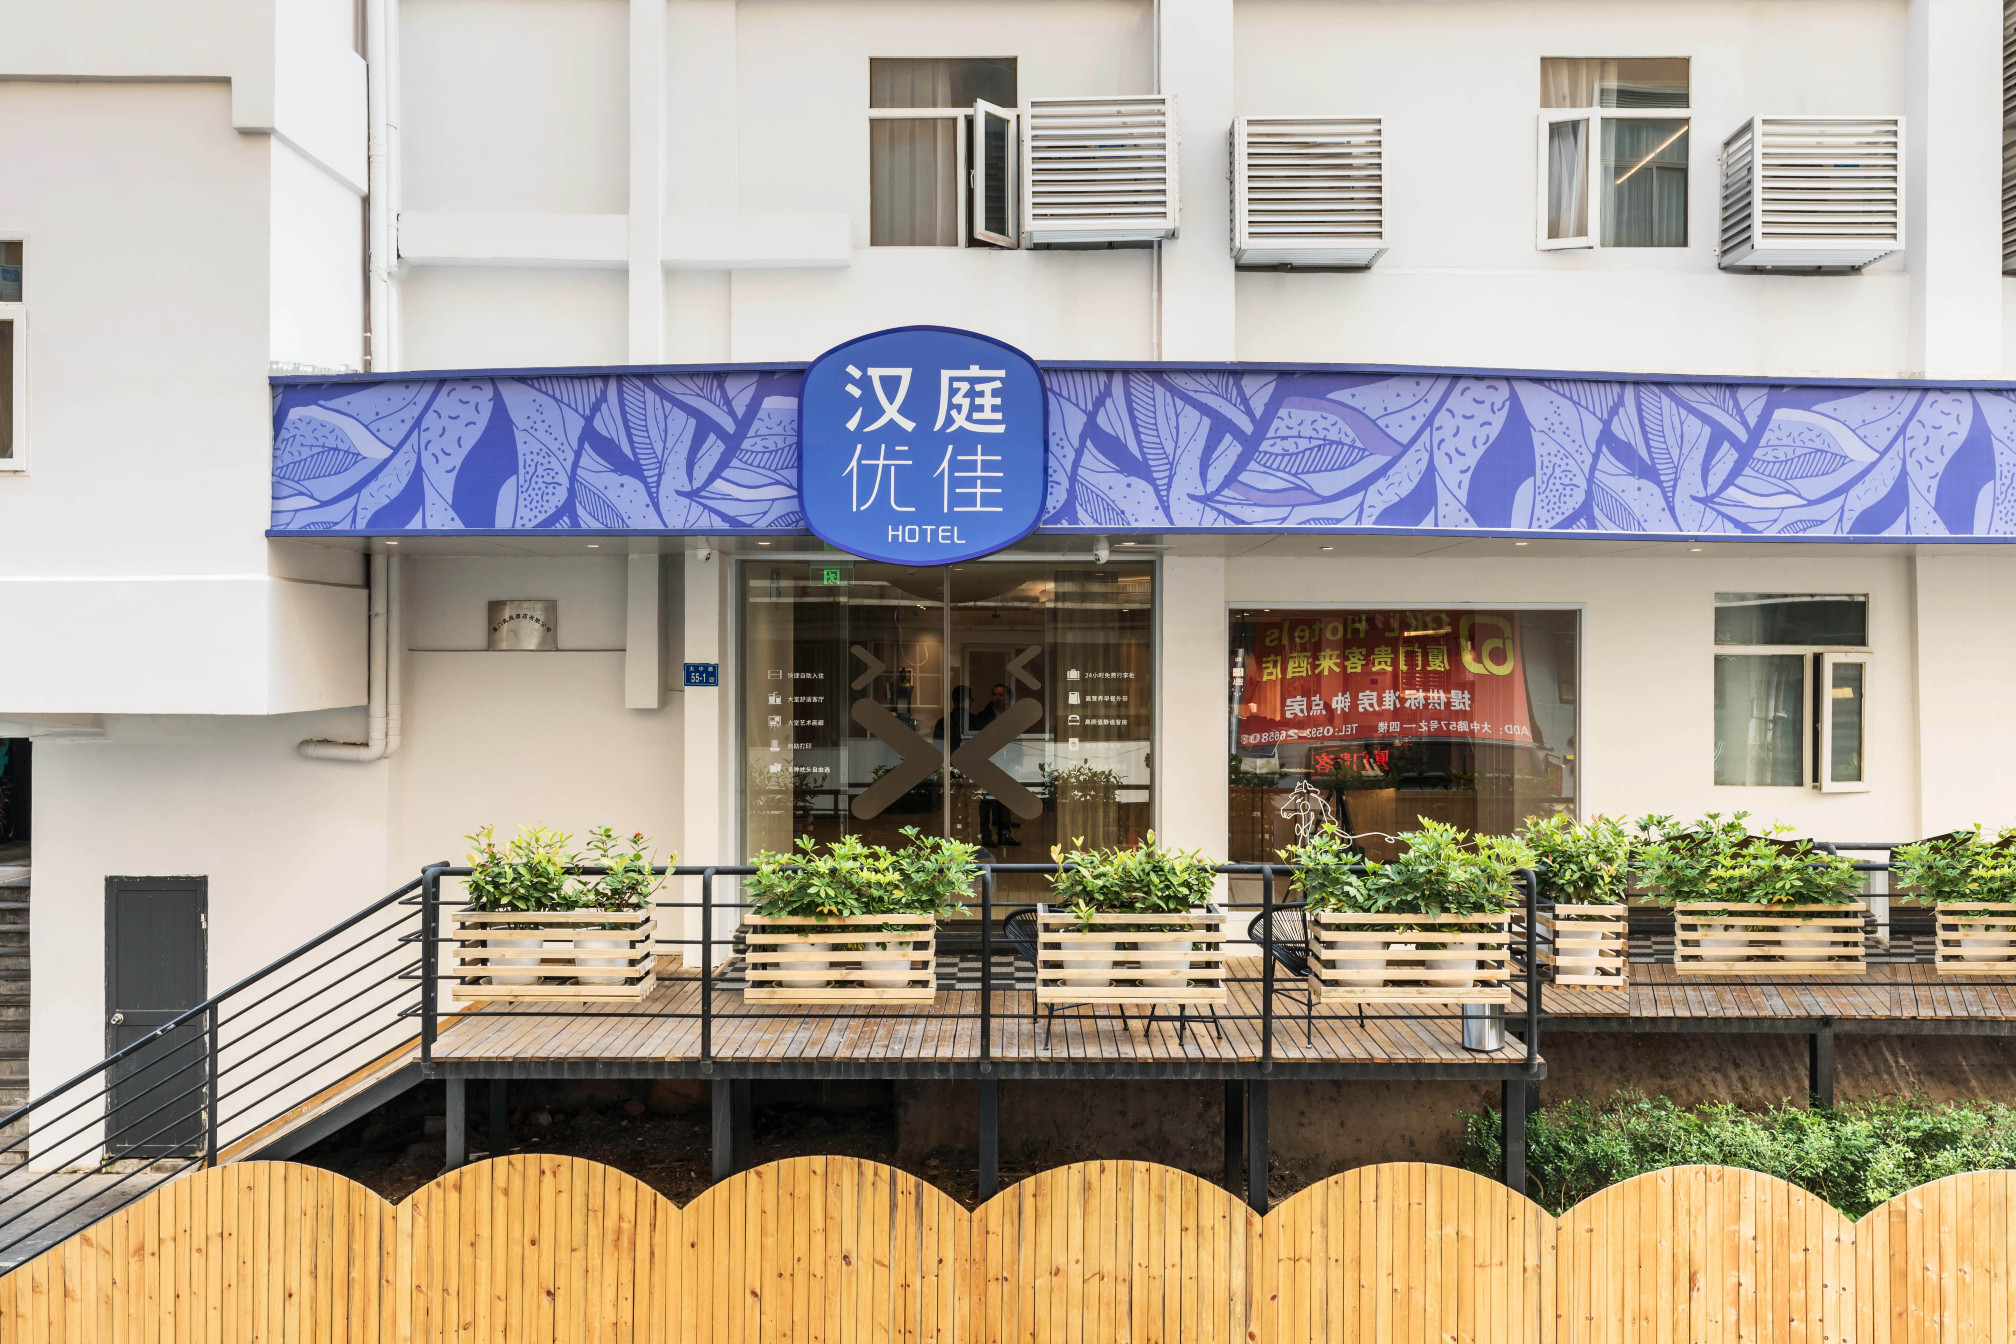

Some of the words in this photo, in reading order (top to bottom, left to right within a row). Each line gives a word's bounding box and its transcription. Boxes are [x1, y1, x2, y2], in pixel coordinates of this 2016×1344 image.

[844, 364, 1006, 433] 汉庭
[841, 443, 1004, 514] 优佳
[888, 525, 966, 544] HOTEL
[690, 672, 706, 683] 55-1
